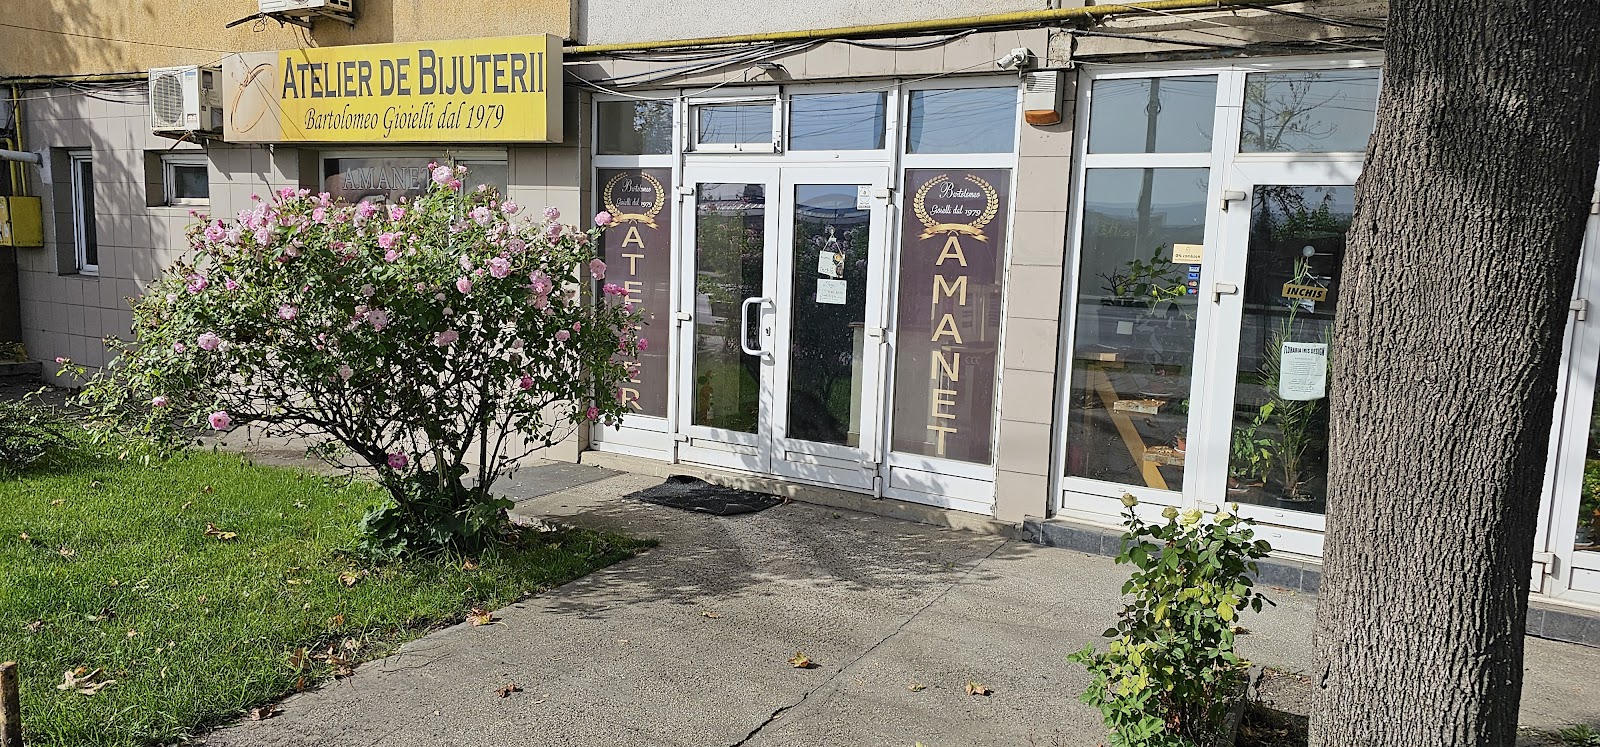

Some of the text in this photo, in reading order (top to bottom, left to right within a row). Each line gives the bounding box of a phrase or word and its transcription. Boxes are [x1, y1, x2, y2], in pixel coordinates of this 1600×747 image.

[281, 49, 544, 99] ATELIER DE BIJUTERII
[305, 102, 504, 138] Bartolomeo Gioielli dal 1979
[1286, 287, 1323, 299] INCHIS
[927, 236, 968, 455] AMANET
